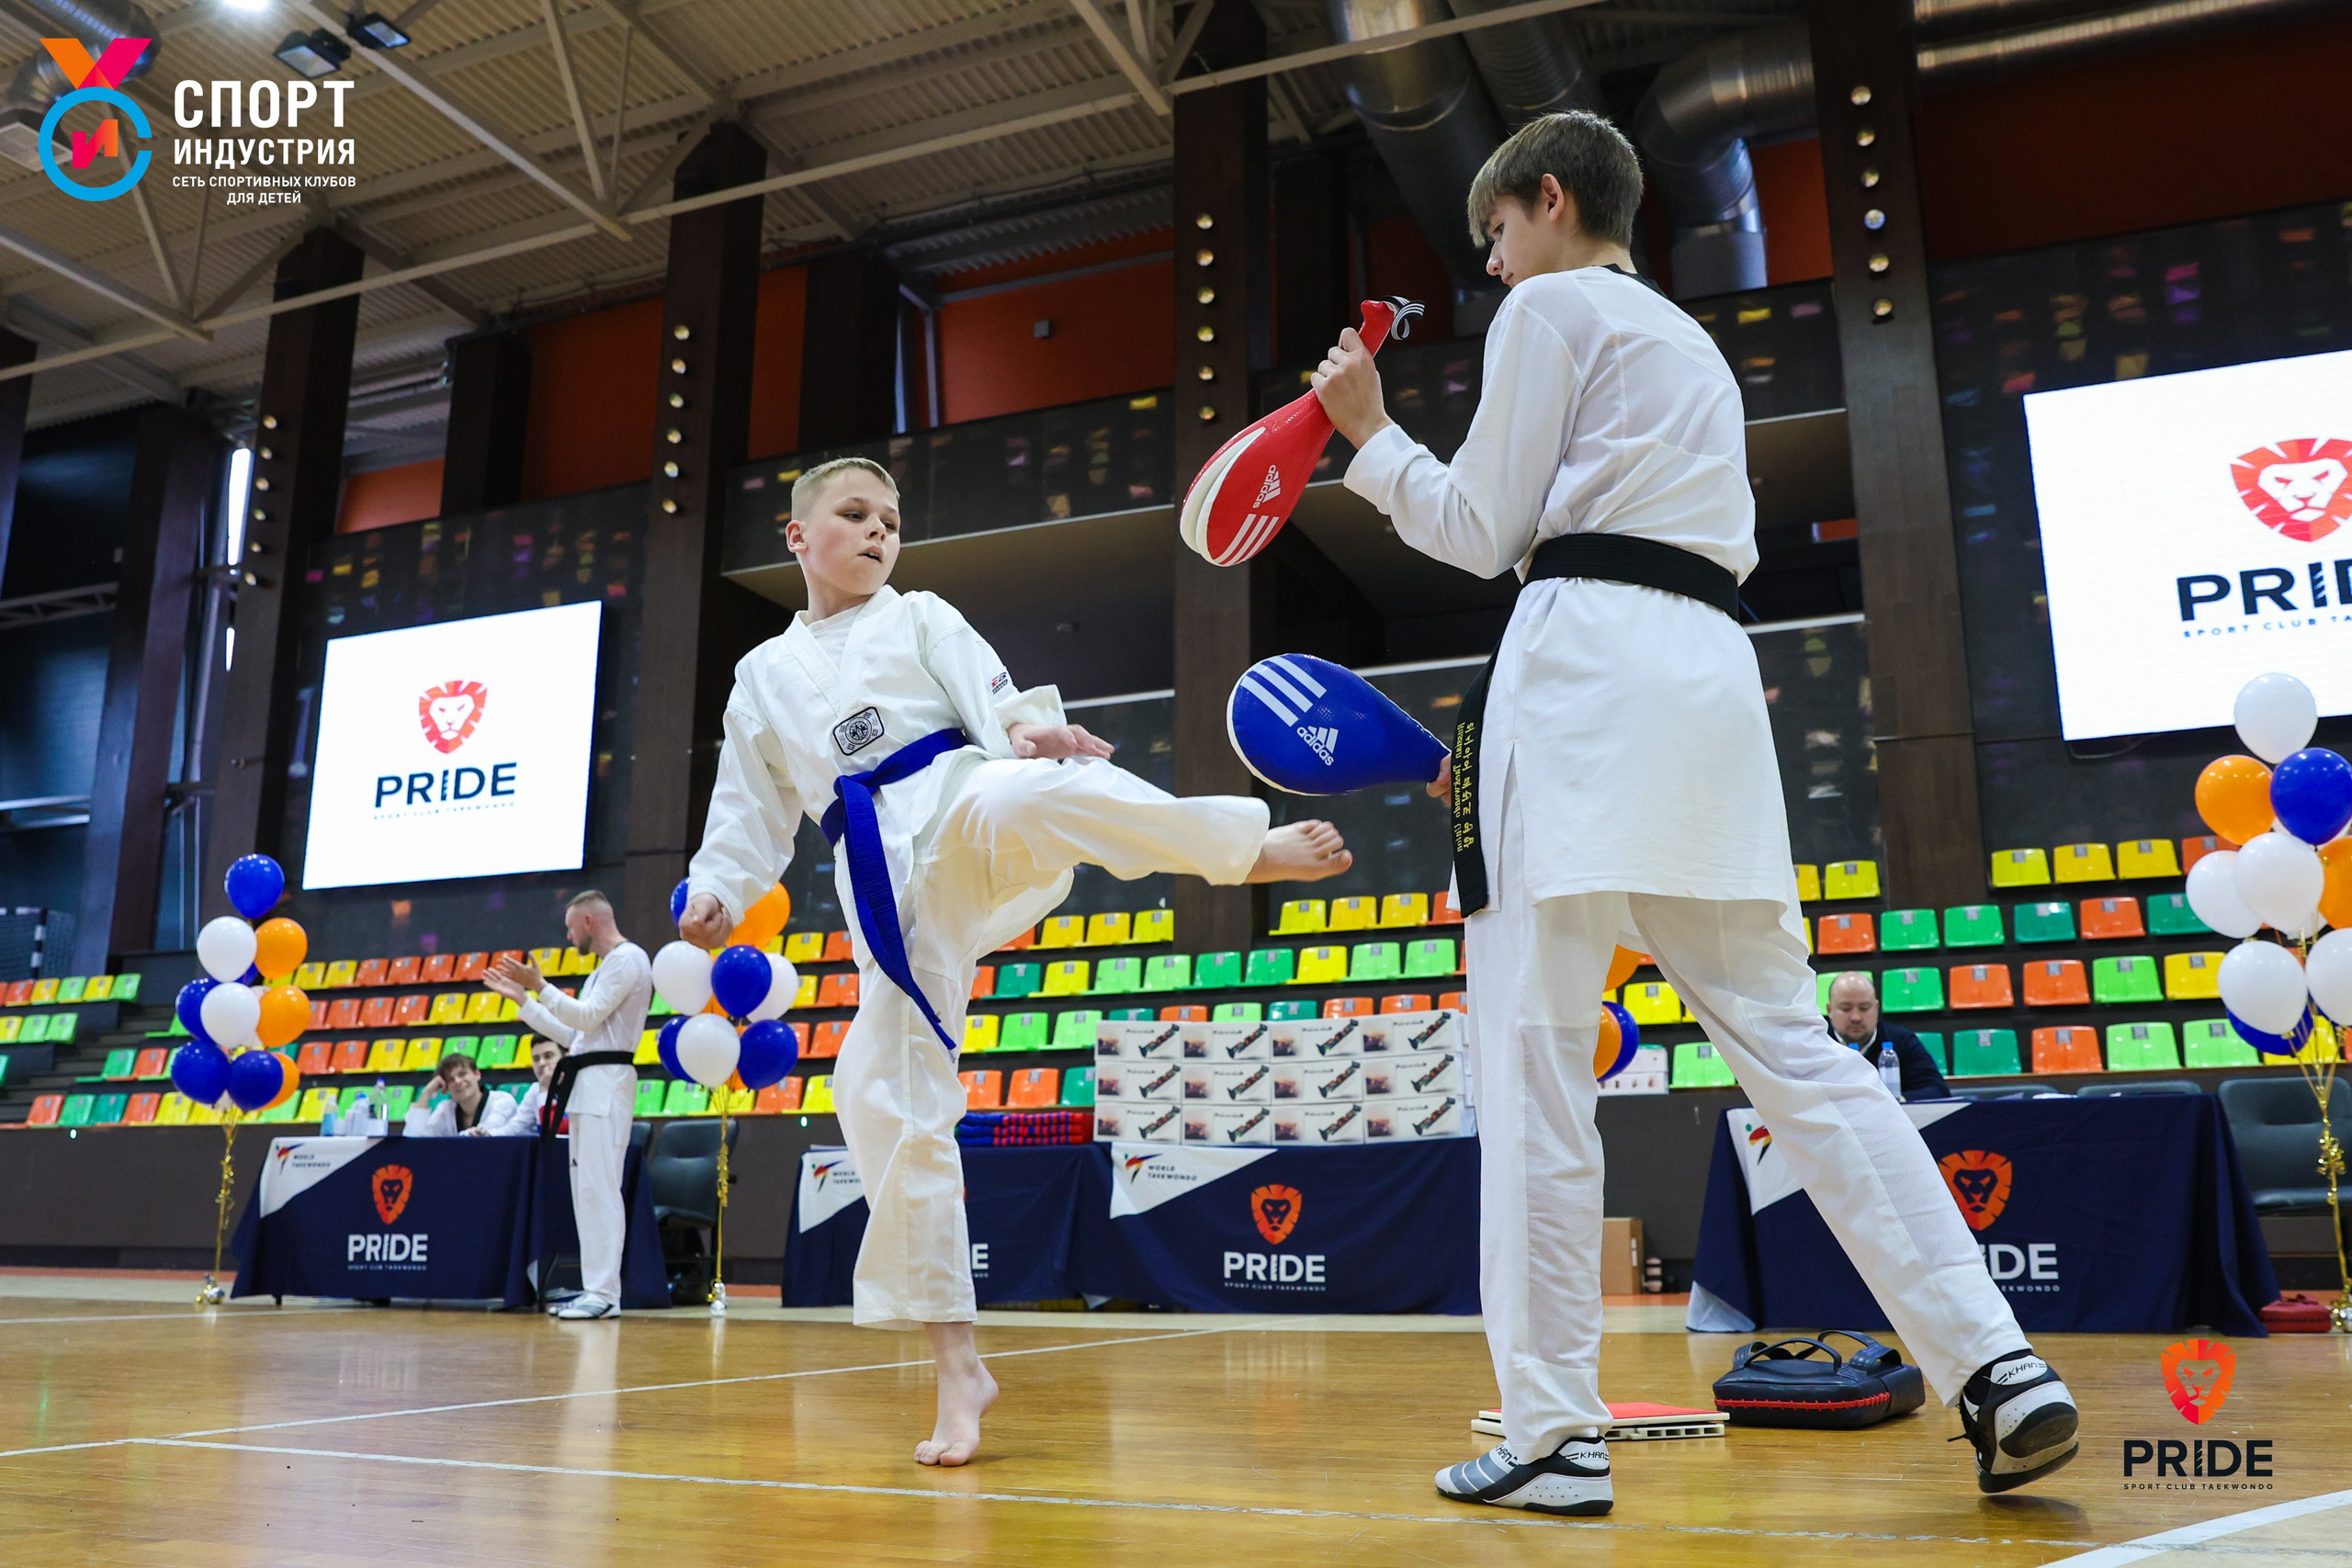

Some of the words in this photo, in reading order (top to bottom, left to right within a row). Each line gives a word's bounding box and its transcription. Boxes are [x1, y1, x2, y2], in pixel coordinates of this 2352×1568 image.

[1252, 464, 1277, 509] adidas
[2176, 558, 2352, 622] PRI
[2183, 625, 2249, 637] SPORT
[2263, 618, 2317, 631] CLUB
[1296, 726, 1335, 767] adidas
[375, 761, 517, 808] PRIDE
[347, 1233, 429, 1262] PRIDE
[1223, 1250, 1327, 1283] PRIDE
